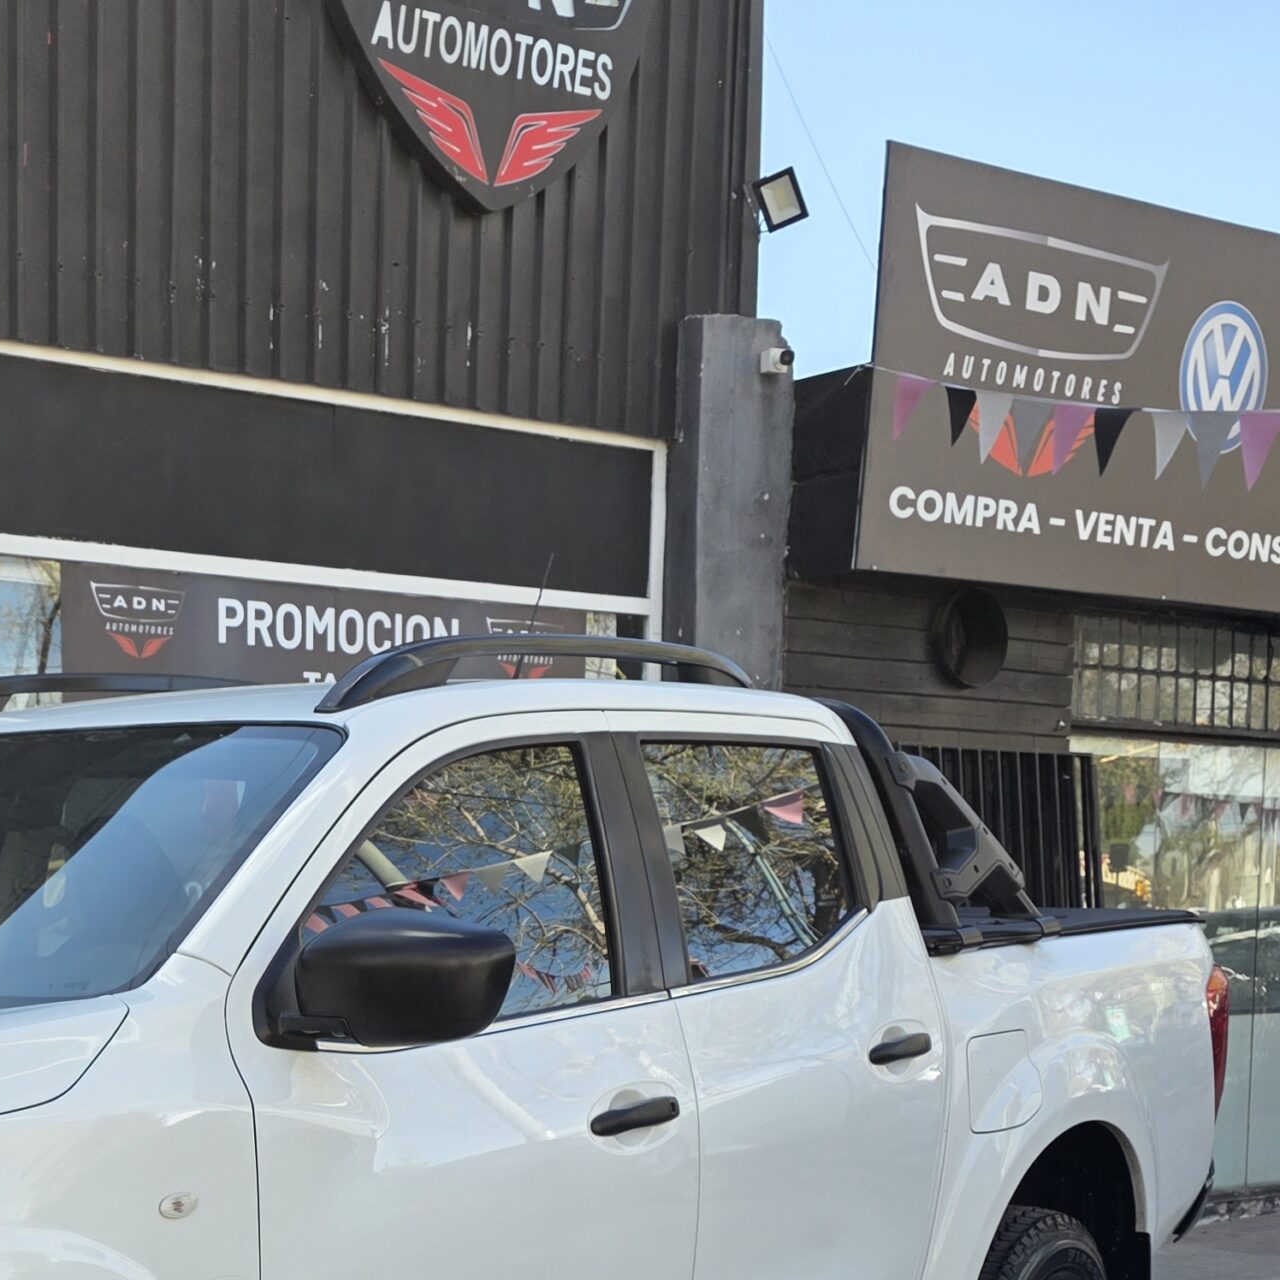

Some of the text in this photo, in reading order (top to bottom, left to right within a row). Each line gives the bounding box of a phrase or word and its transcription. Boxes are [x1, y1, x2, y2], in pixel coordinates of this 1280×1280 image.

[370, 0, 613, 100] AUTOMOTORES
[971, 262, 1112, 326] ADN
[943, 352, 1123, 405] AUTOMOTORES
[888, 485, 1041, 535] COMPRA
[1074, 509, 1175, 552] VENTA
[105, 622, 174, 636] AUTOMOTORES
[113, 594, 166, 612] ADN
